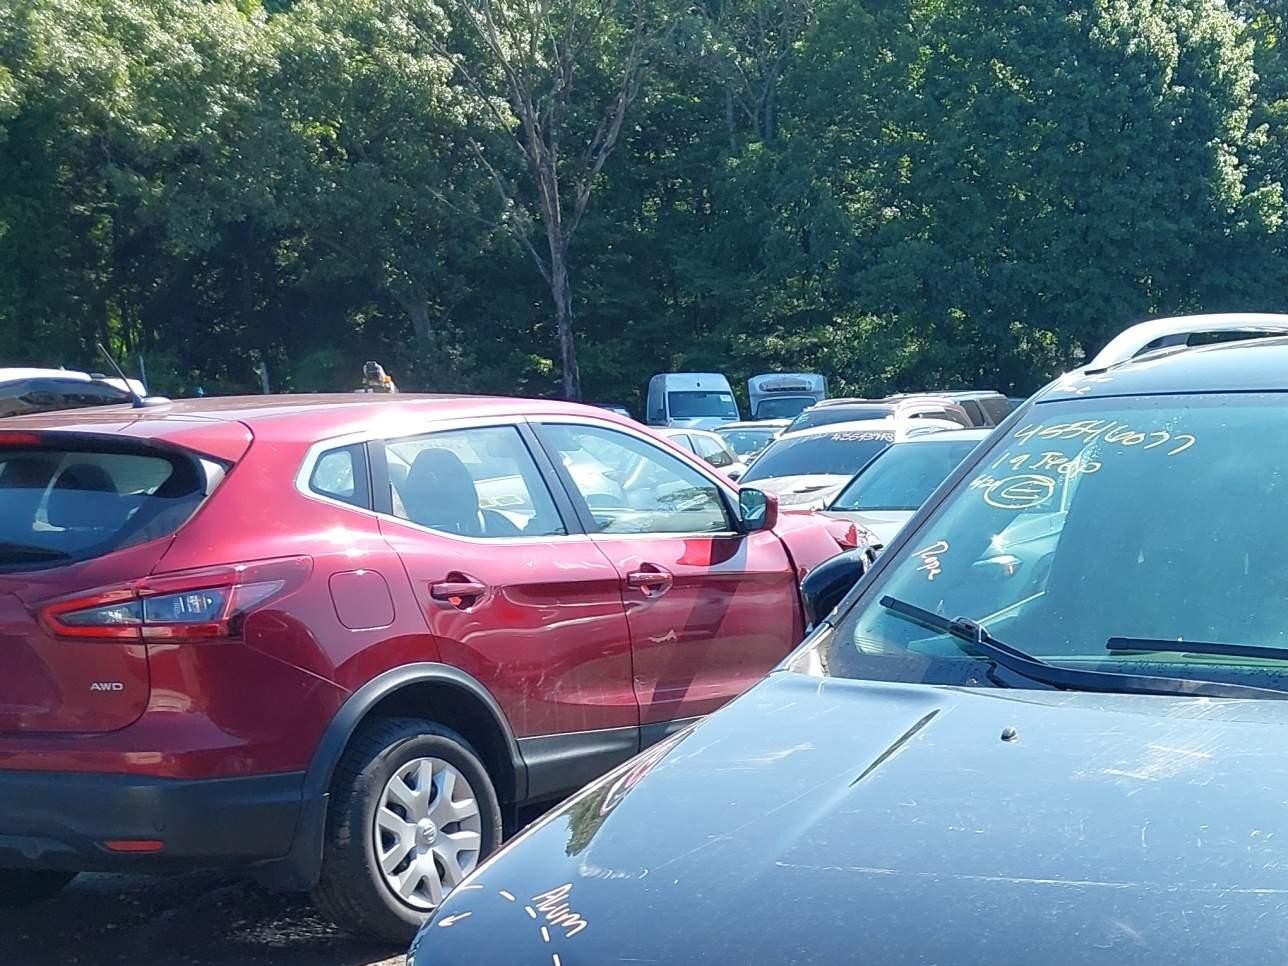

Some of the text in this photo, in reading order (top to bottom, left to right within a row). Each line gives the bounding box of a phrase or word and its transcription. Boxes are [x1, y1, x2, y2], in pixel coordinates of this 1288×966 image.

[1014, 419, 1196, 456] 45546077
[992, 452, 1031, 471] 19
[90, 682, 124, 691] AWD
